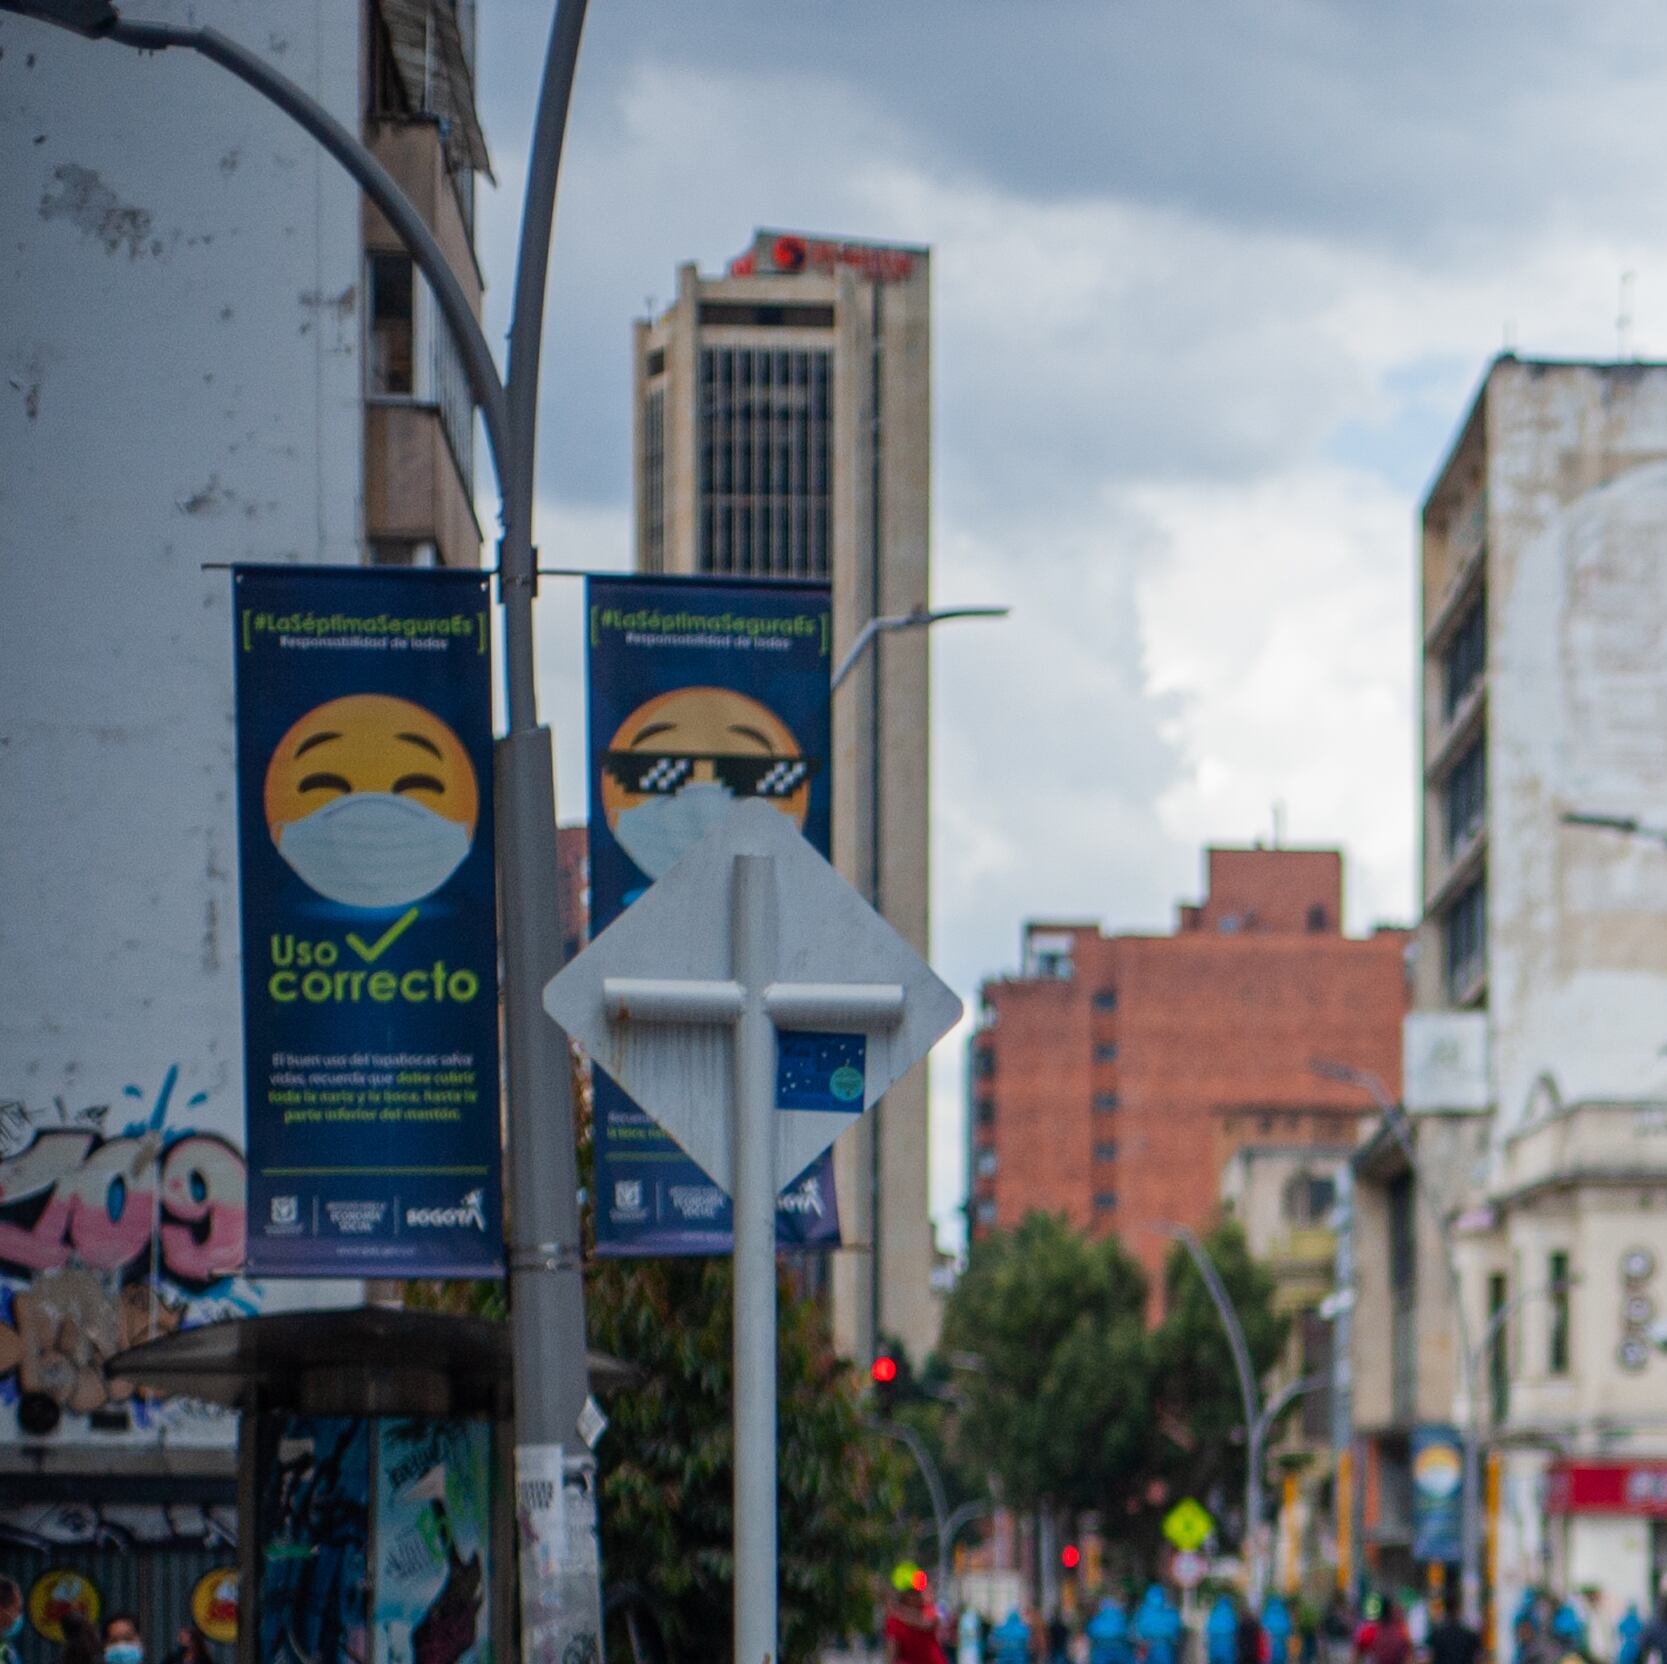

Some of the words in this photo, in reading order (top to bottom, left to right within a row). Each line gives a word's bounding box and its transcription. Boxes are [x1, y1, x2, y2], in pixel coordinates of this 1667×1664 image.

[390, 637, 407, 650] de
[270, 934, 338, 967] Uso
[268, 960, 480, 1003] correcto
